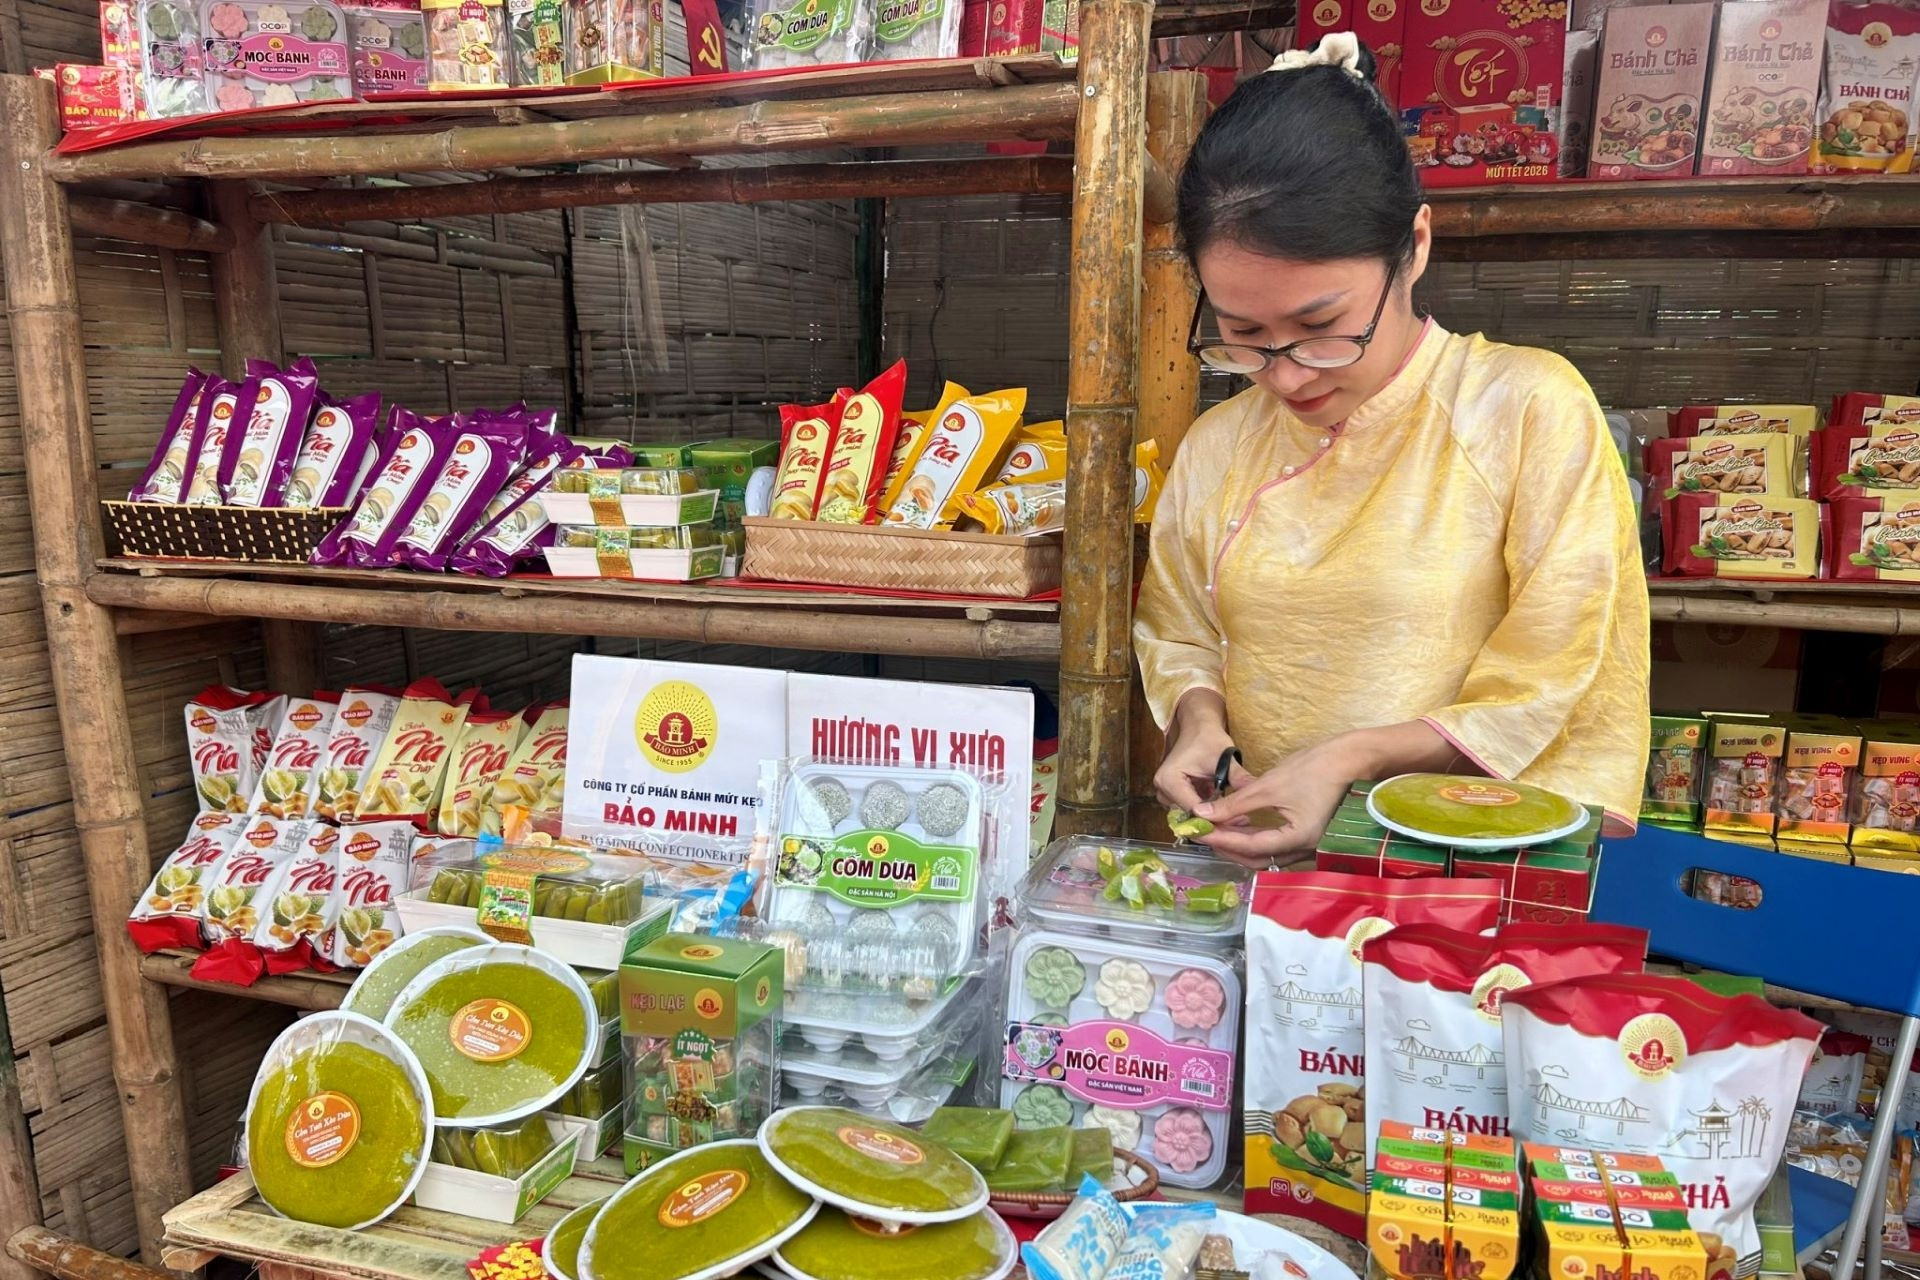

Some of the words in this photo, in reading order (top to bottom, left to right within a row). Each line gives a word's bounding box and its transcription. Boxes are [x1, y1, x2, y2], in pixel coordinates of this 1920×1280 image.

[1611, 49, 1658, 70] Bánh
[1664, 48, 1698, 67] Chả
[1724, 44, 1772, 62] Bánh
[1778, 42, 1814, 61] Chả
[1840, 82, 1881, 99] BÁNH
[1884, 85, 1910, 102] CHẢ
[1485, 164, 1505, 178] MỨT
[1505, 164, 1521, 178] TẾT
[1523, 165, 1549, 177] 2026
[195, 741, 240, 775] Pía
[273, 738, 322, 768] Pía
[328, 736, 372, 768] Pía
[394, 729, 448, 763] Pía
[672, 746, 696, 756] MINH
[409, 763, 435, 775] Chay
[459, 743, 510, 783] Pía
[656, 755, 675, 766] SINCE
[676, 758, 693, 766] 1955
[583, 779, 612, 792] CÔNG
[616, 783, 628, 793] TY
[681, 789, 711, 803] BÁNH
[714, 791, 739, 805] MỨT
[603, 796, 656, 828] BẢO
[664, 809, 738, 837] MINH
[225, 855, 275, 886] Pía
[289, 862, 337, 892] Pía
[878, 857, 917, 882] DỪA
[342, 871, 392, 906] Pía
[631, 992, 656, 1013] KẸO
[660, 993, 686, 1014] LẠC
[677, 1038, 684, 1050] ÍT
[686, 1040, 709, 1053] NGỌT
[1066, 1047, 1109, 1074] MỘC
[1114, 1054, 1169, 1082] BÁNH
[1298, 1047, 1365, 1077] BÁN
[1088, 1079, 1101, 1088] ĐẶC
[1101, 1081, 1114, 1089] SẢN
[1114, 1082, 1128, 1092] VIỆT
[1128, 1085, 1143, 1093] NAM
[1423, 1106, 1511, 1137] BÁNH
[1272, 1181, 1288, 1192] ISO
[1680, 1176, 1730, 1210] HẢ
